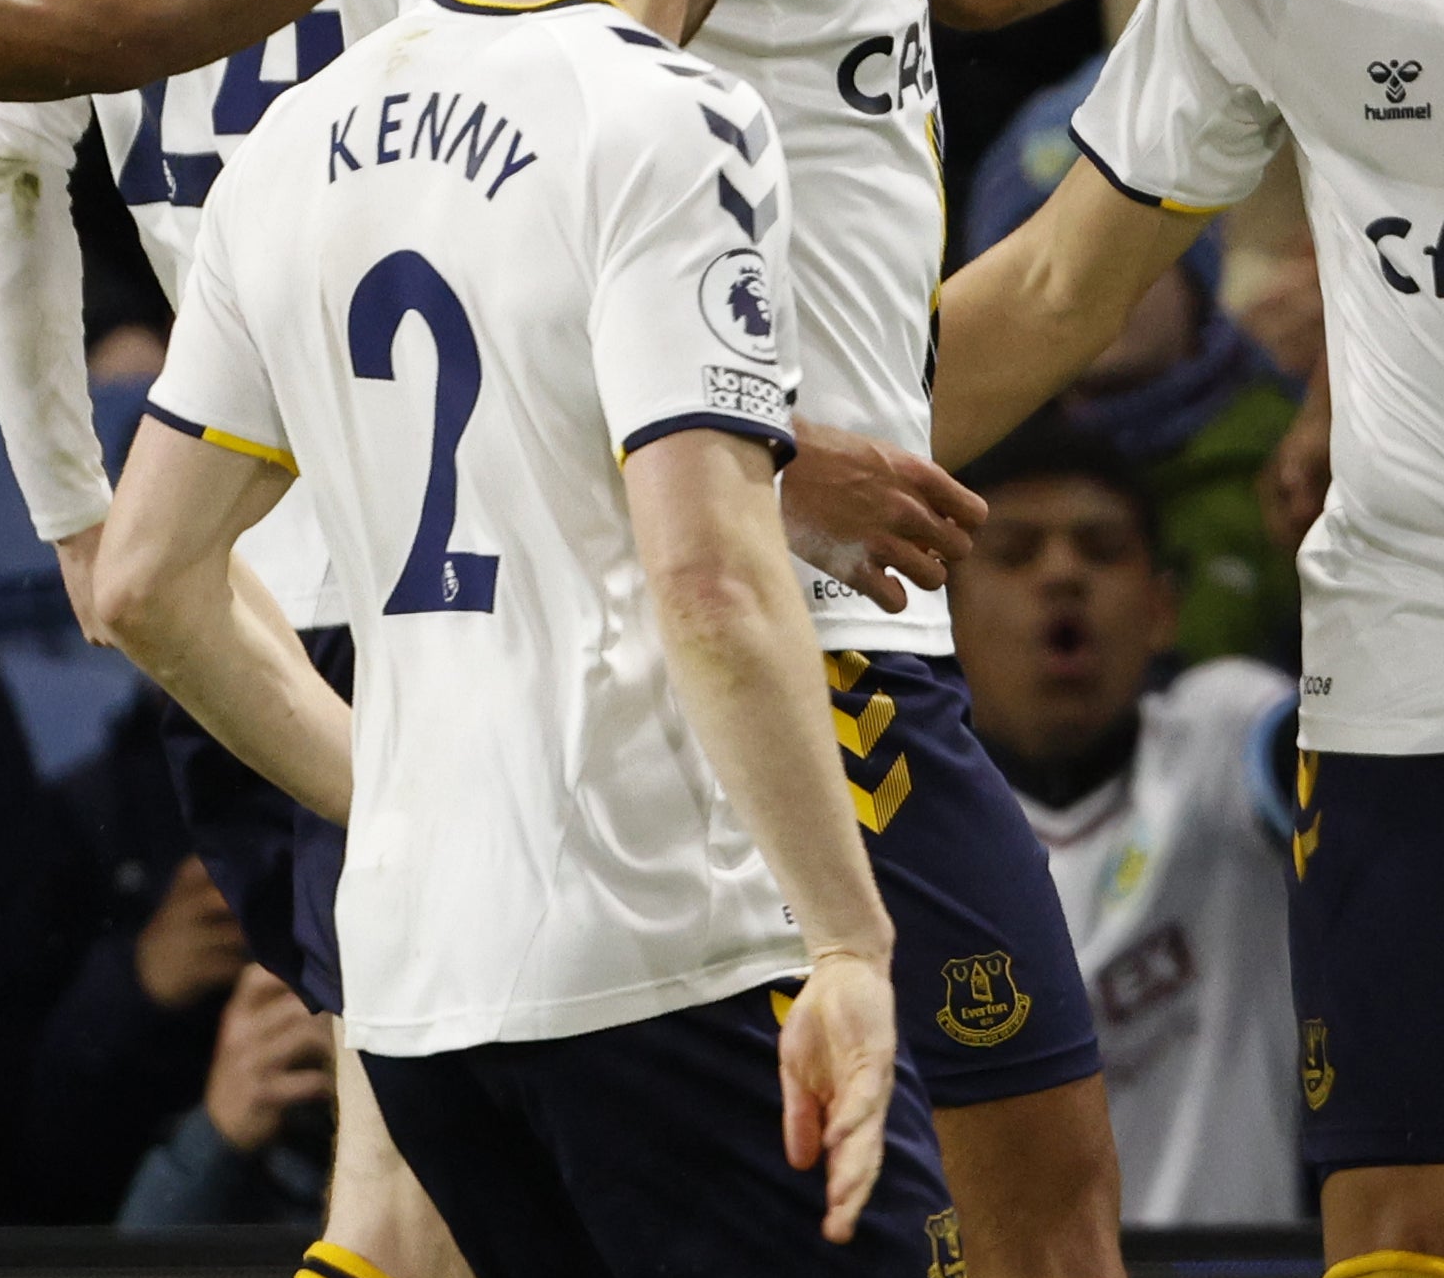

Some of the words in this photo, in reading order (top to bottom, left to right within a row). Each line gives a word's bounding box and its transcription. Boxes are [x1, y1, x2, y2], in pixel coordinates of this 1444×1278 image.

[327, 91, 538, 203] KENNY
[1364, 102, 1432, 121] hummel
[347, 249, 501, 615] 2
